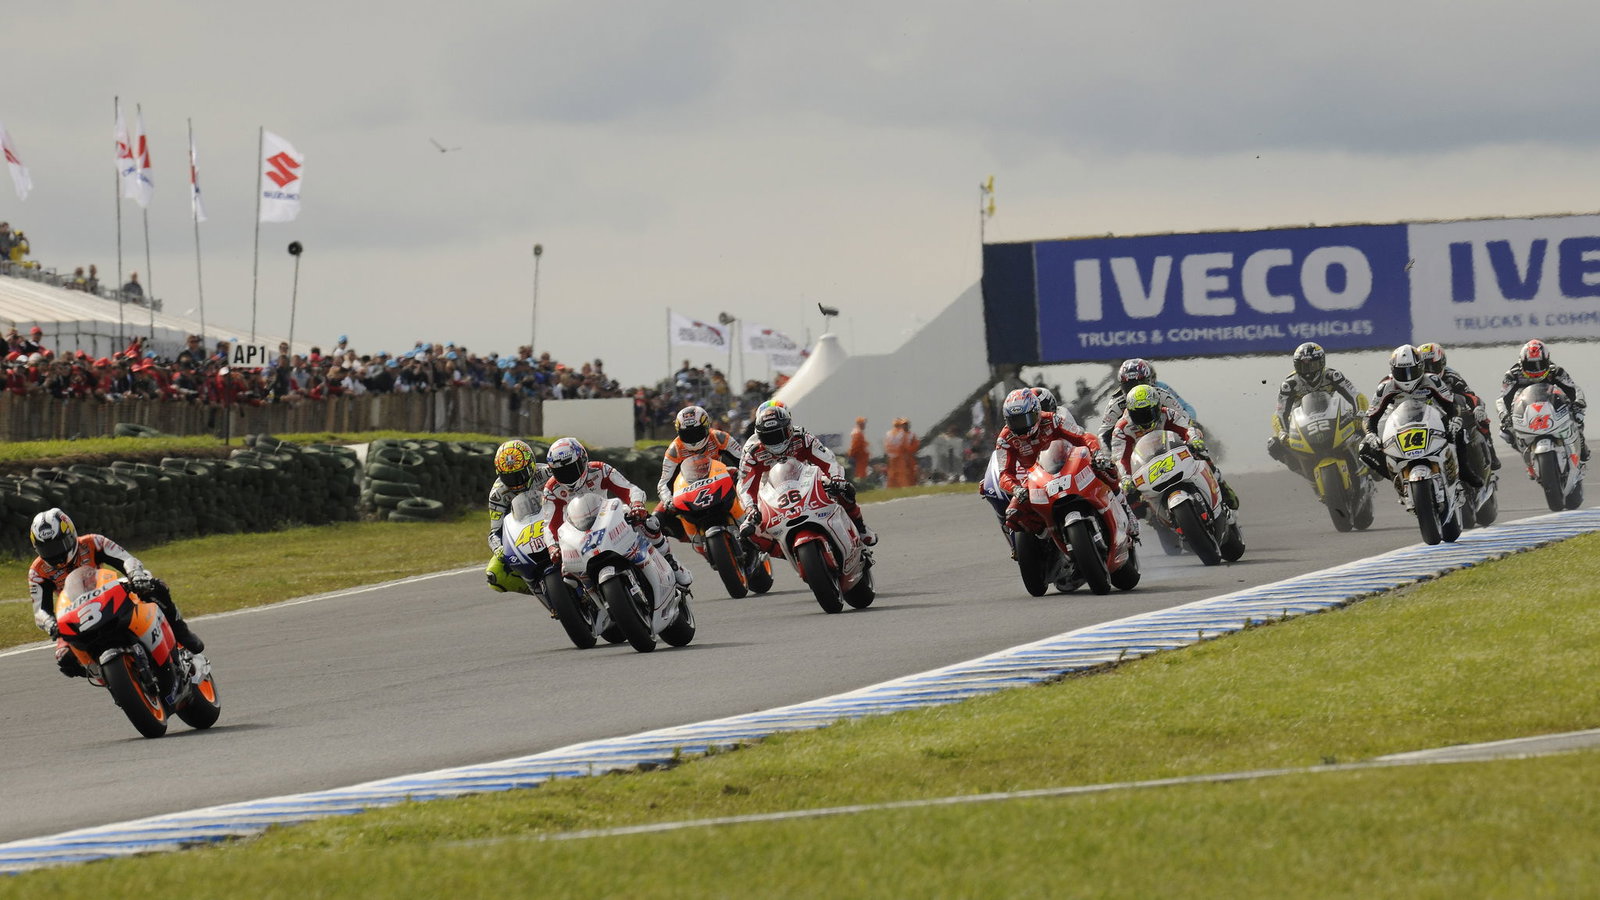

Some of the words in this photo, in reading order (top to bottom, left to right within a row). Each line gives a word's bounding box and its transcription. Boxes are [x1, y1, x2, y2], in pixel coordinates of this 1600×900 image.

[1074, 246, 1373, 321] IVECO
[1455, 314, 1522, 329] TRUCKS
[1078, 330, 1147, 347] TRUCKS
[1151, 330, 1163, 344] &
[1167, 324, 1285, 341] COMMERCIAL
[1288, 320, 1373, 338] VEHICLES
[233, 344, 265, 364] AP1
[1307, 419, 1331, 436] 52
[1403, 431, 1424, 449] 14
[1148, 454, 1175, 484] 24
[693, 487, 714, 508] 4
[777, 489, 802, 508] 36
[515, 519, 545, 547] 46
[78, 601, 102, 633] 3
